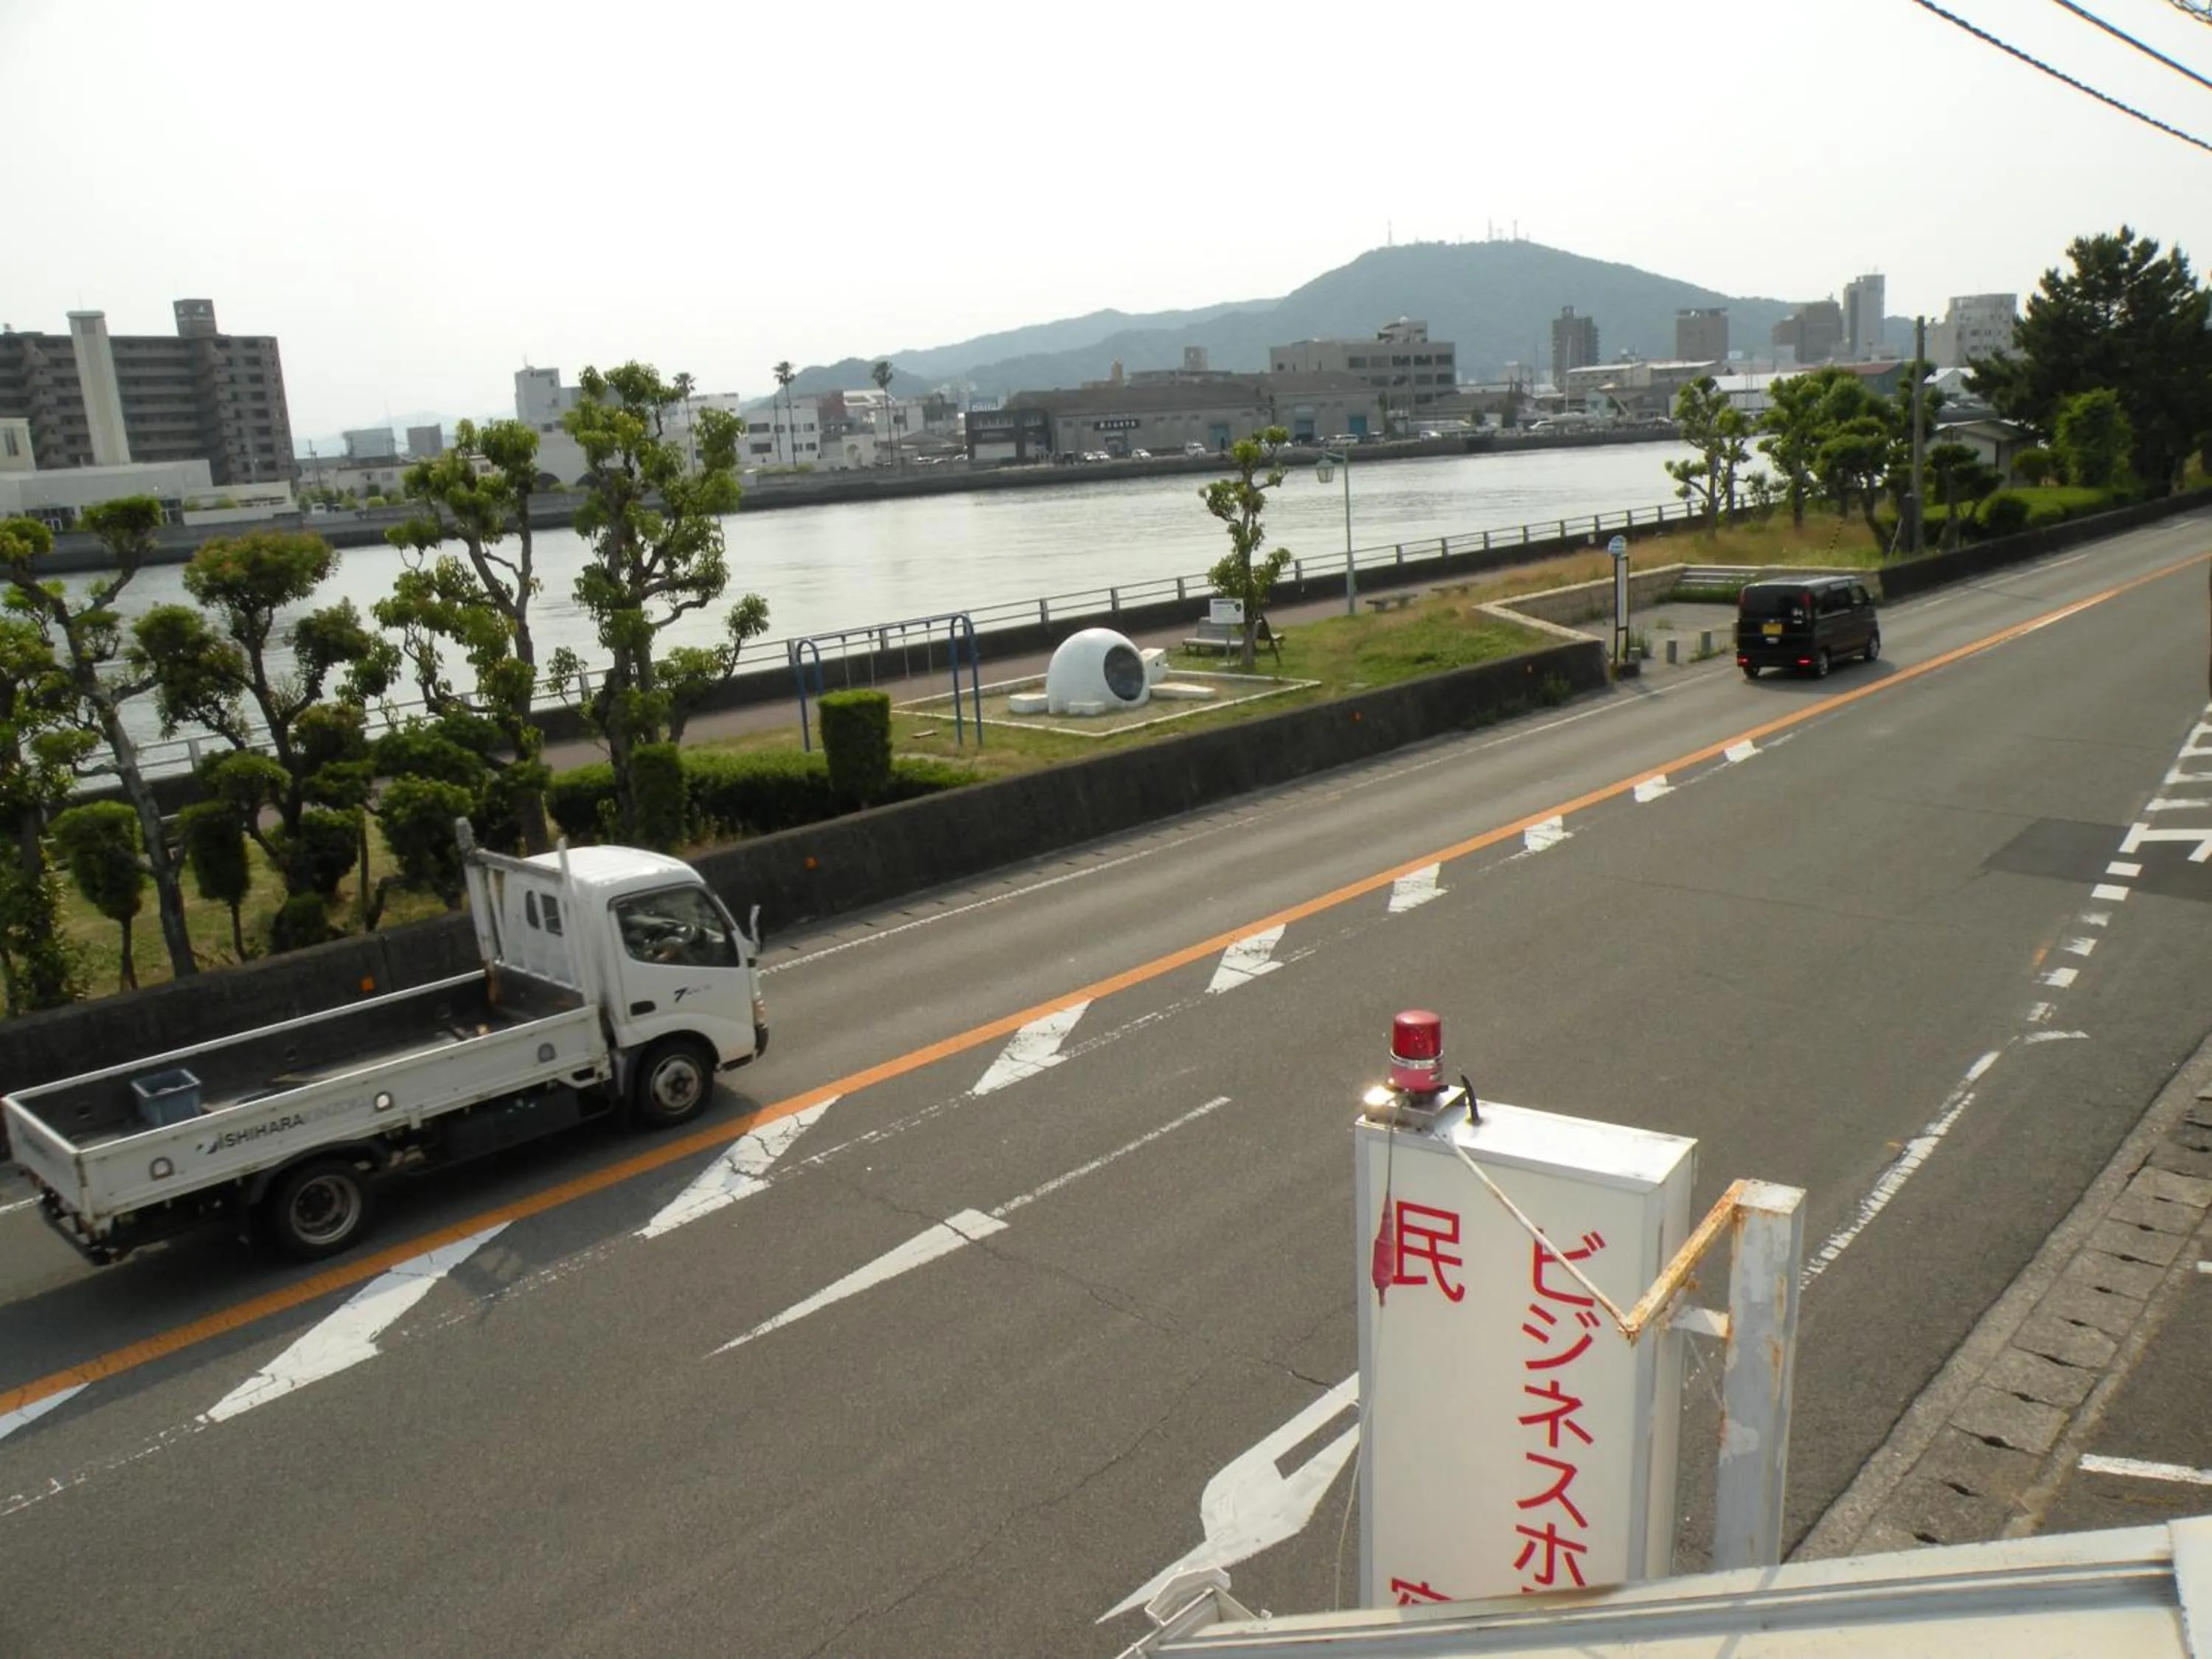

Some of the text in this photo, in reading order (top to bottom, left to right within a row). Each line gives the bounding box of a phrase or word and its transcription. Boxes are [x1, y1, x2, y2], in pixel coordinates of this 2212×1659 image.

[1513, 1228, 1606, 1593] ビジネスホ
